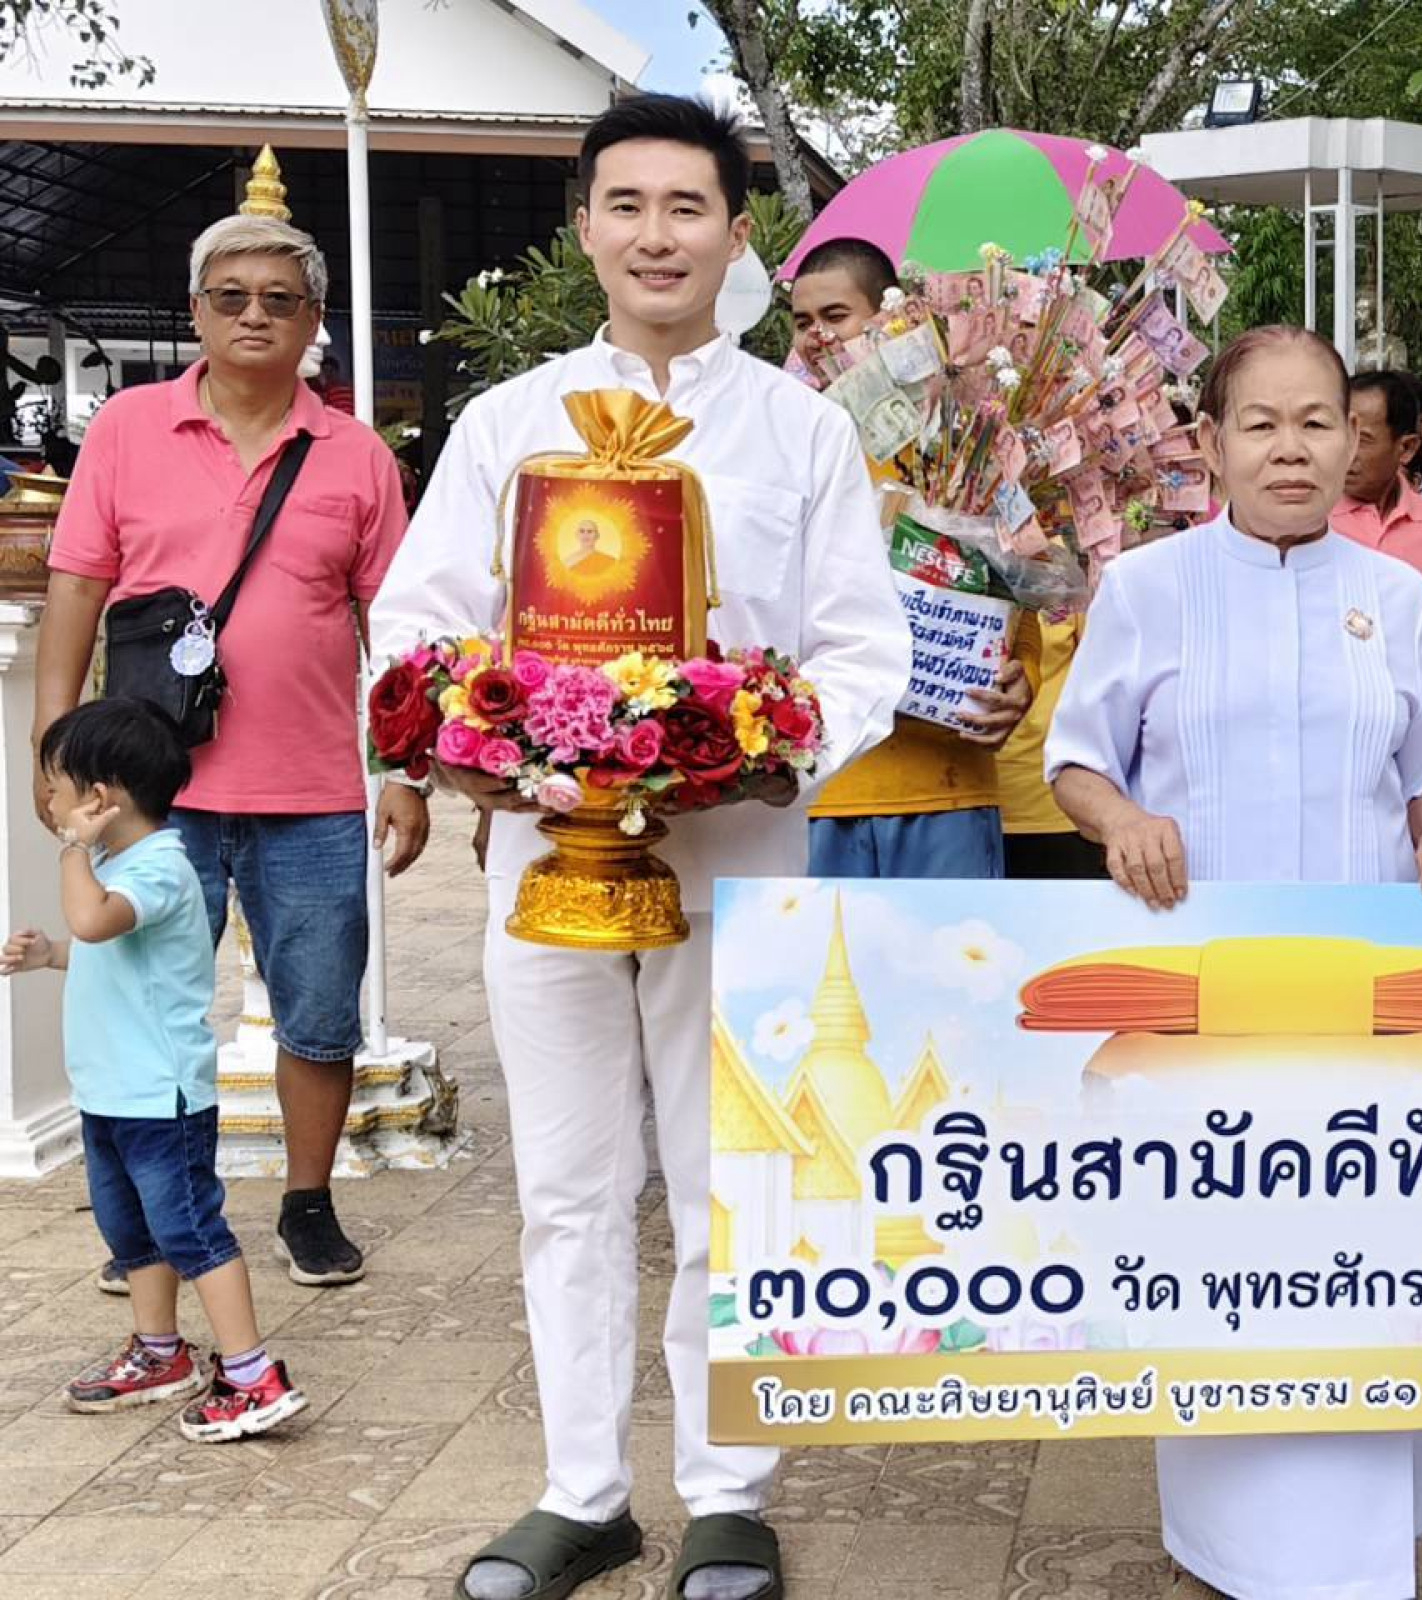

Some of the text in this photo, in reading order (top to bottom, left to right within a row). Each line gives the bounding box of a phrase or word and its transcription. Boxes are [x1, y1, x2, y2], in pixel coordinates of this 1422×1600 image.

[518, 605, 674, 633] กฐินสามัคคีทั่วไทย
[748, 1263, 1085, 1330] ๓๐,๐๐๐
[1111, 1255, 1181, 1311] วัด
[757, 1381, 831, 1419] โดย
[849, 1371, 1155, 1424] คณะศิษยานุศิษย์
[1170, 1380, 1348, 1422] บูชาธรรม
[1365, 1379, 1417, 1405] ๘๑
